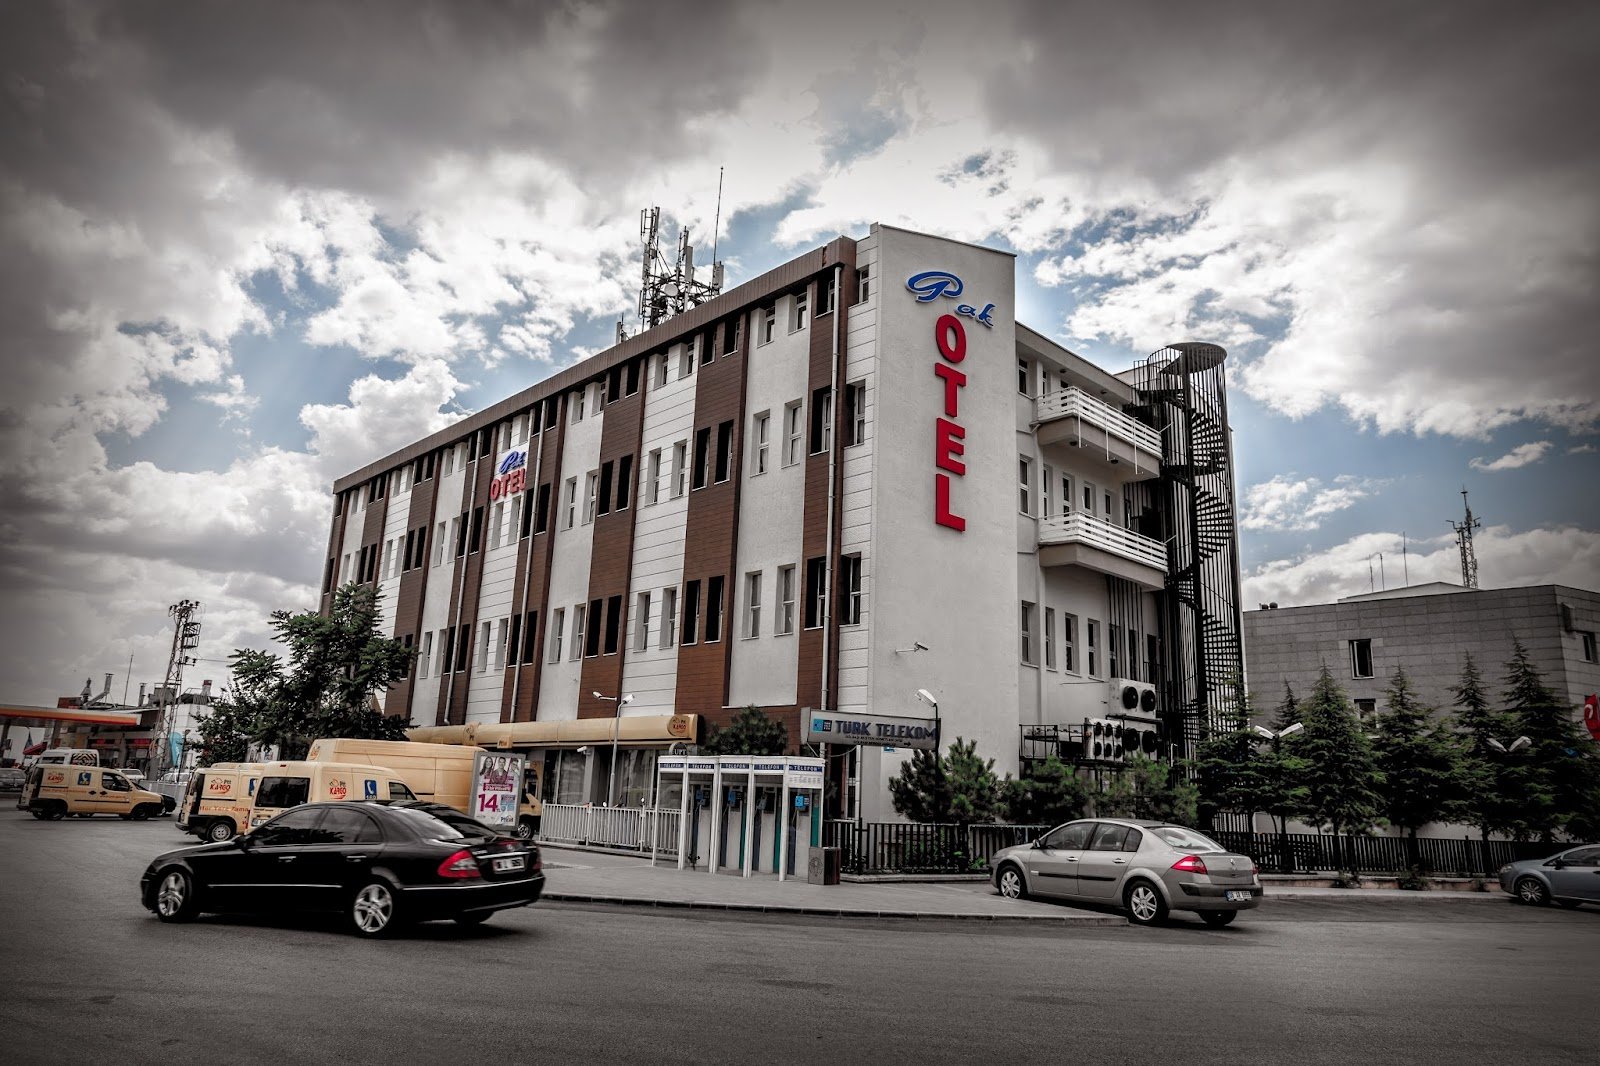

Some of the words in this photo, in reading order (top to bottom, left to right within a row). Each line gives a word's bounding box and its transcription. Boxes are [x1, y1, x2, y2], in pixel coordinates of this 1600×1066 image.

[905, 271, 995, 329] Pak
[934, 314, 967, 532] OTEL
[490, 468, 526, 501] OTEL
[835, 720, 871, 736] TÜRK
[875, 723, 938, 741] TELEKOM
[478, 793, 498, 812] 14
